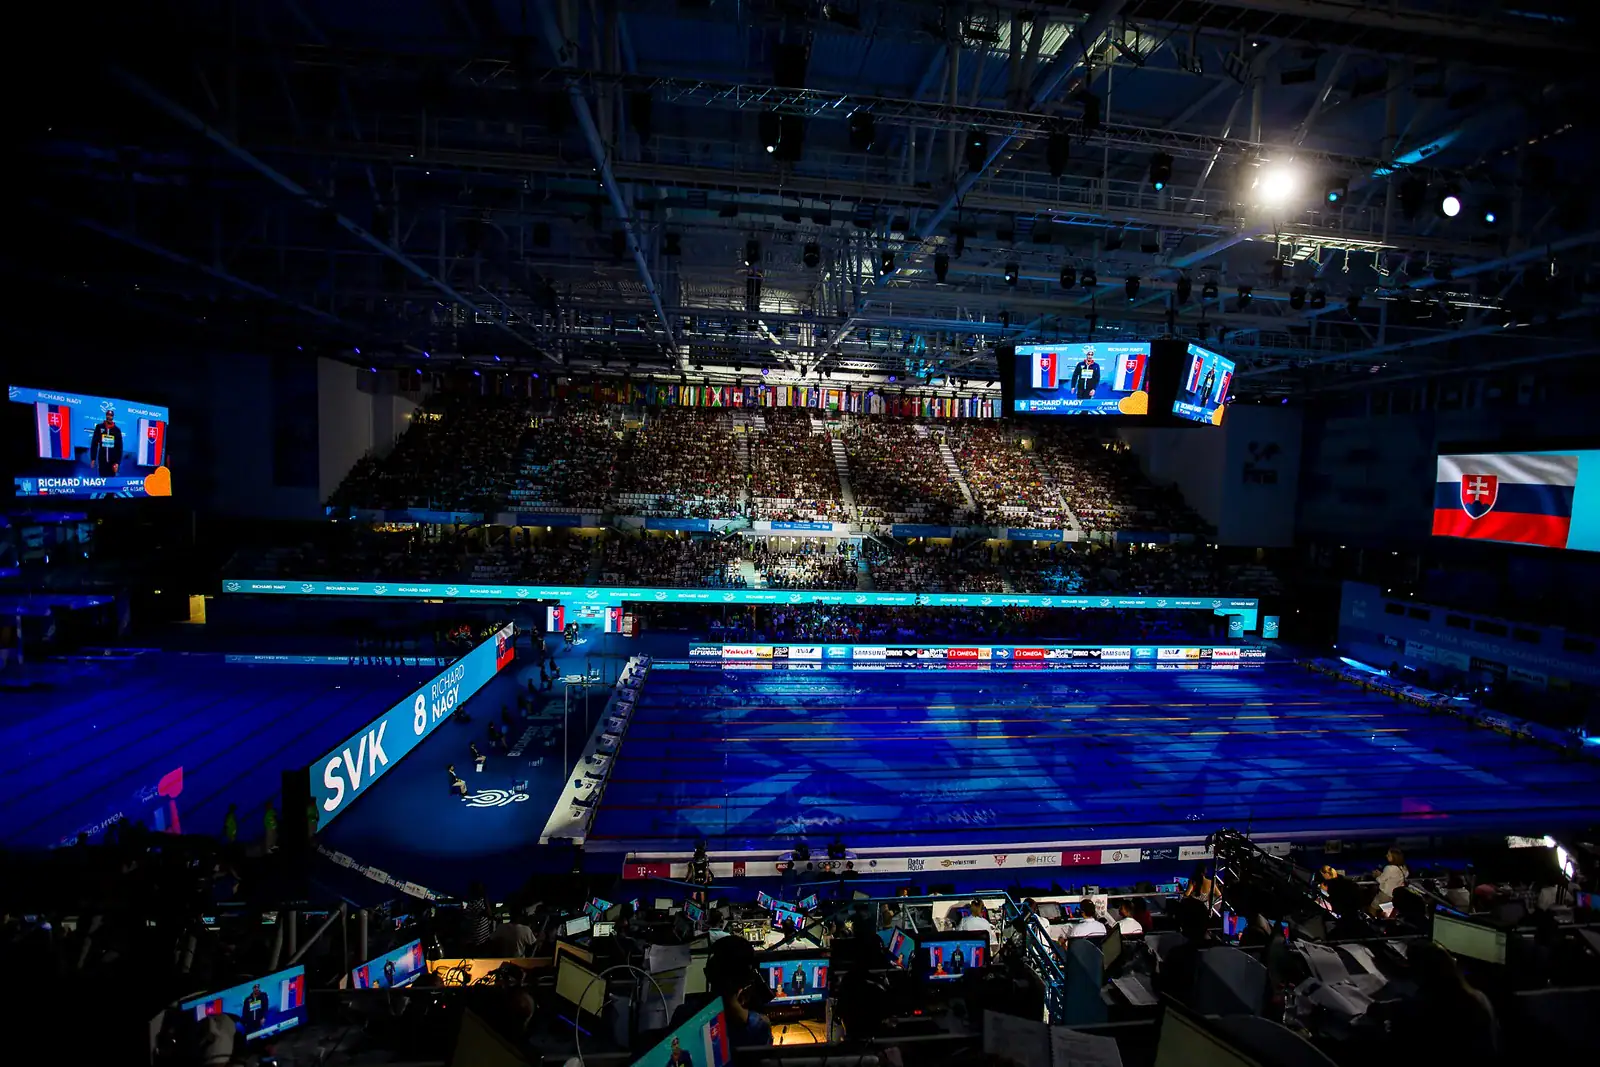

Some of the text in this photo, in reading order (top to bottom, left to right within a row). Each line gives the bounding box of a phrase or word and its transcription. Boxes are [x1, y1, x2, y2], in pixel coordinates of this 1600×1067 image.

[37, 391, 65, 402] RICHARD
[38, 477, 107, 487] RICHARD NAGY
[432, 664, 465, 701] RICHARD
[413, 693, 427, 736] 8
[431, 684, 460, 723] NAGY
[323, 719, 389, 812] SVK
[1036, 855, 1057, 863] HTCC
